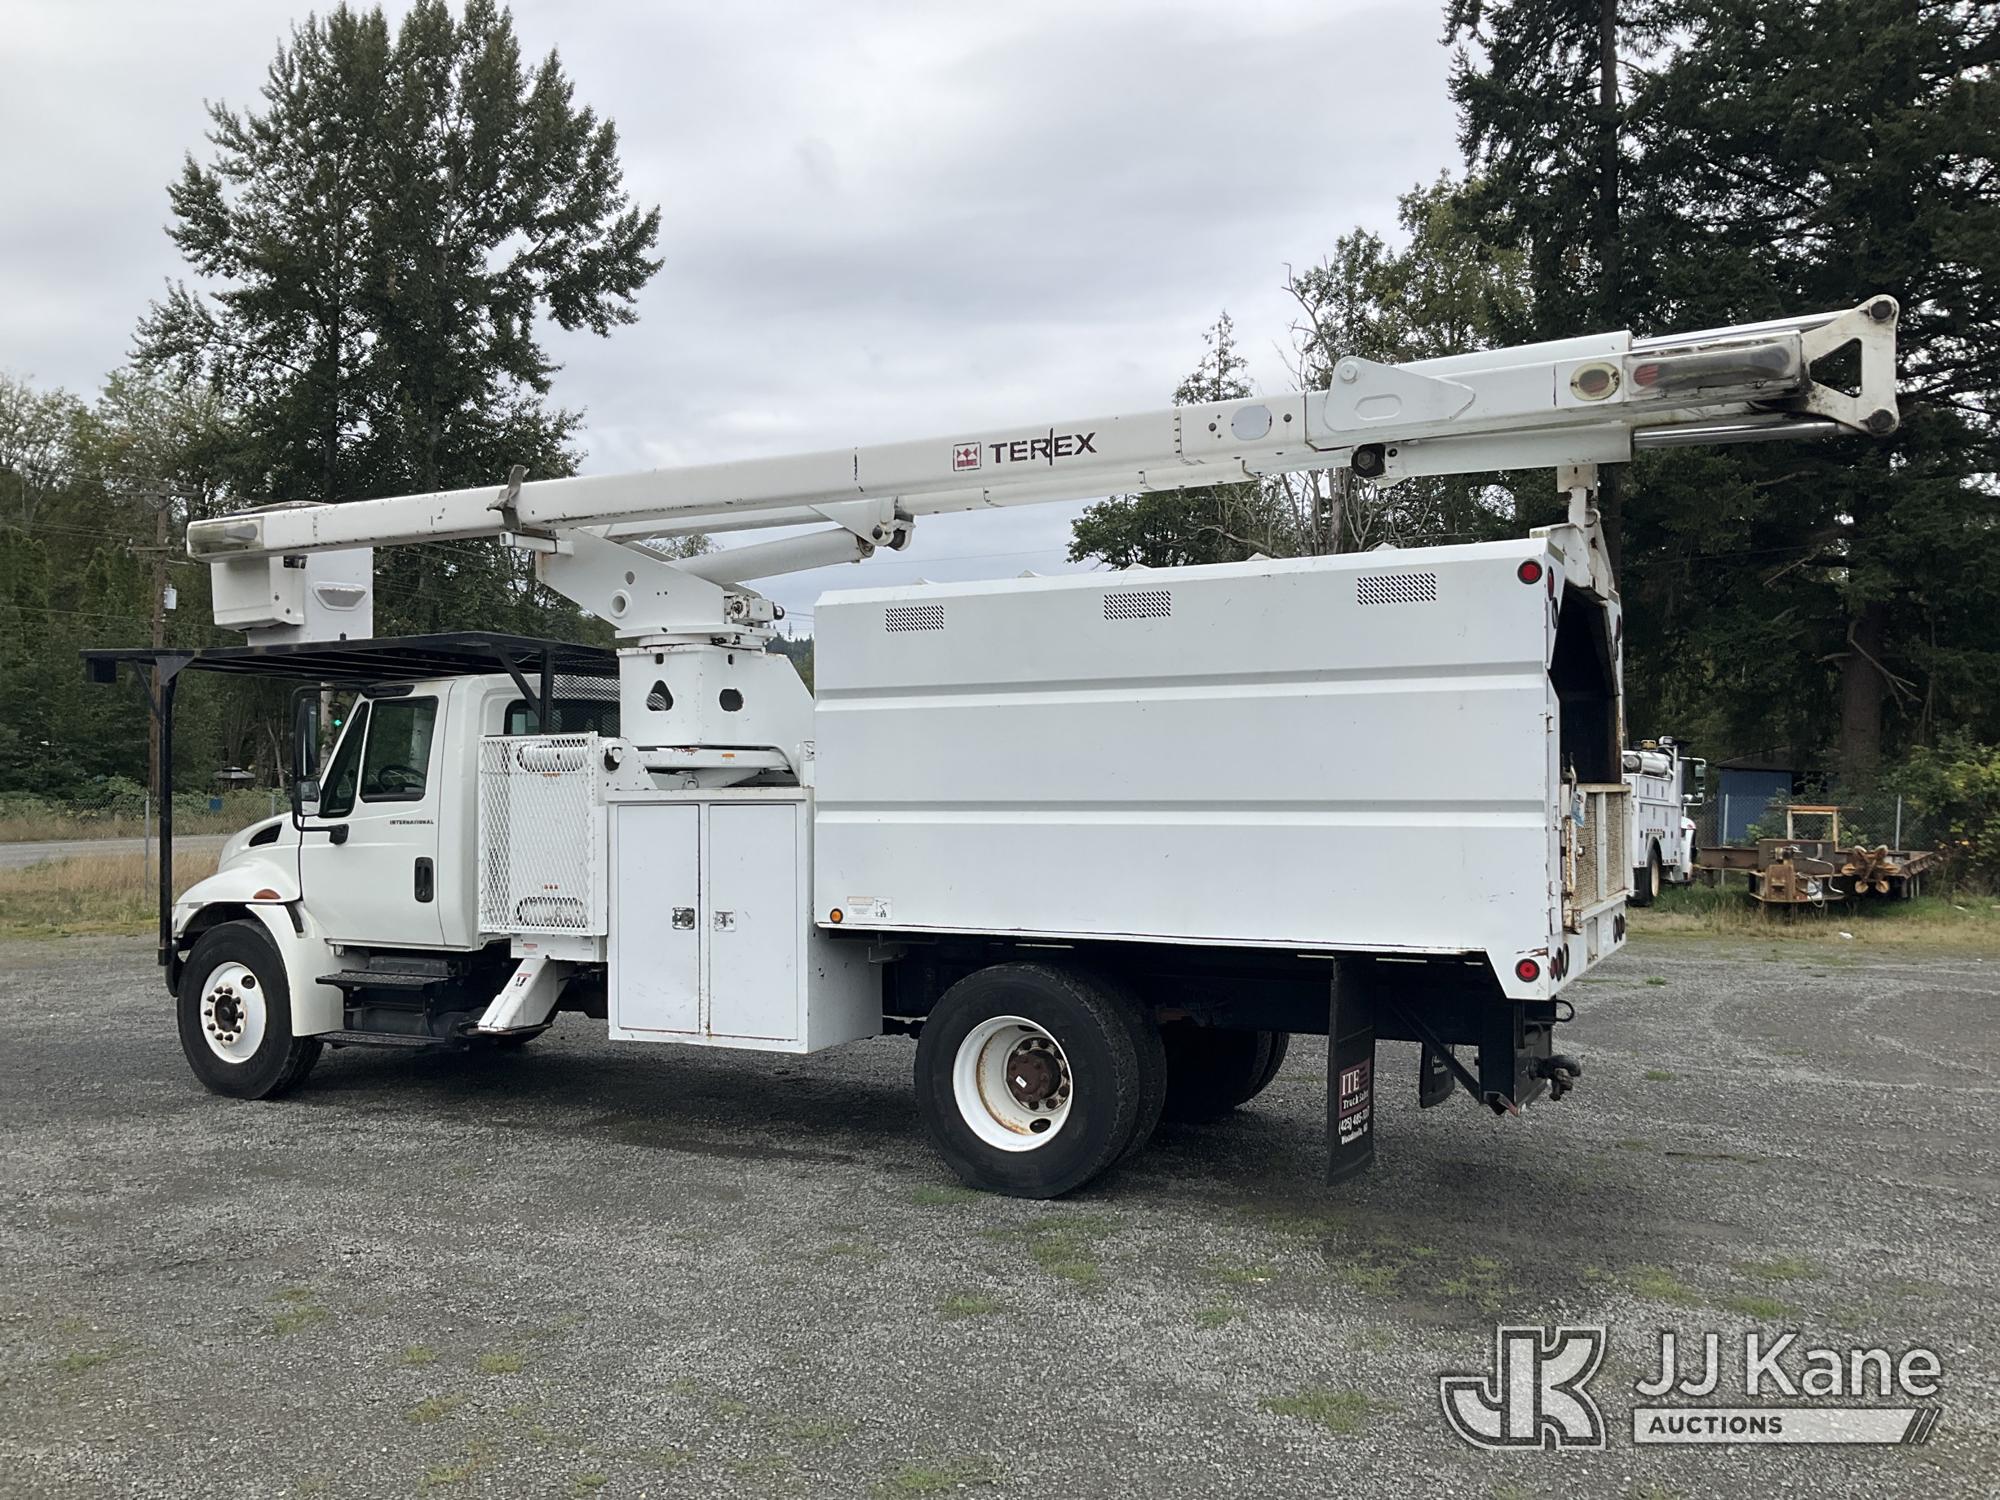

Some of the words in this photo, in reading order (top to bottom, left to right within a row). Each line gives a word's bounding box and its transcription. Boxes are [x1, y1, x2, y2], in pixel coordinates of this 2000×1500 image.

[988, 430, 1098, 465] TEREX
[1341, 1069, 1360, 1096] ITE
[1343, 1094, 1359, 1110] Truck
